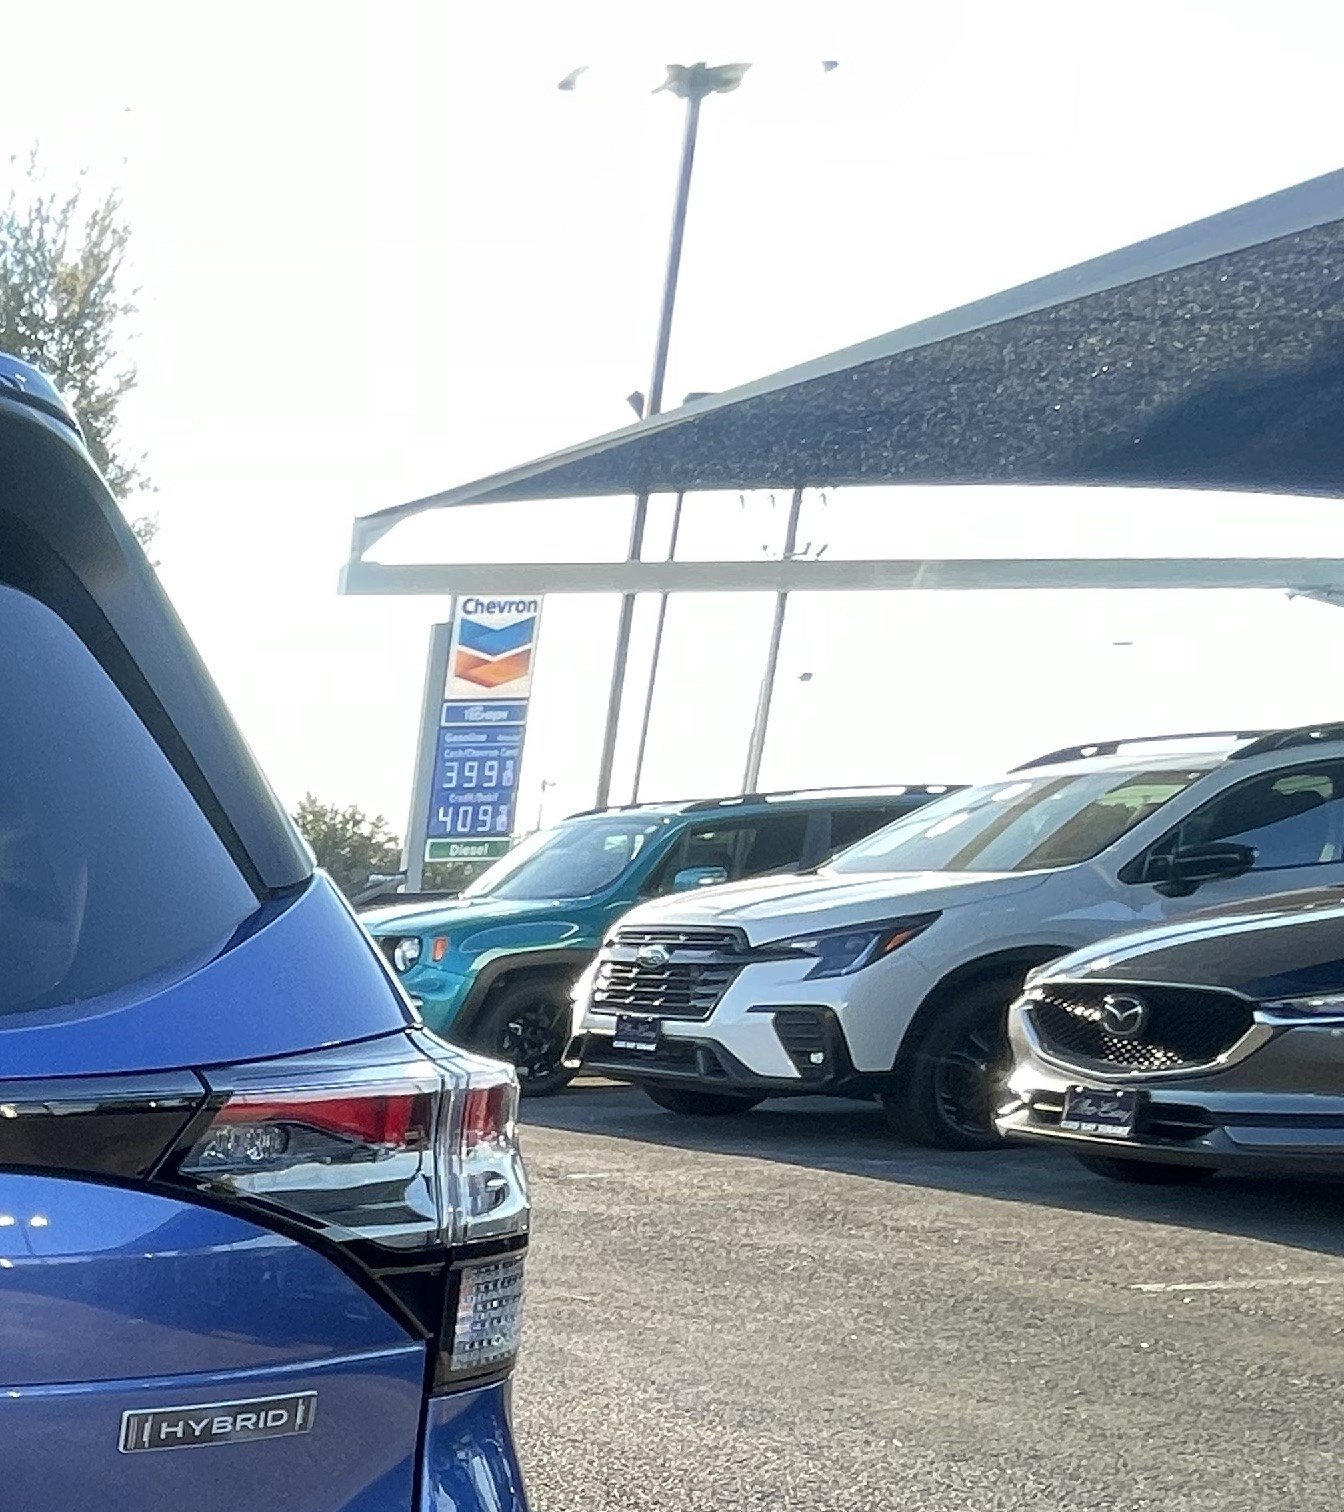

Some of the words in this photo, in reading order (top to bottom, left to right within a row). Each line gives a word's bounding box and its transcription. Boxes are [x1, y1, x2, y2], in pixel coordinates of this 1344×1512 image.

[462, 598, 538, 616] Chevron
[449, 843, 490, 857] Diesel
[159, 1409, 289, 1440] HYBRID
